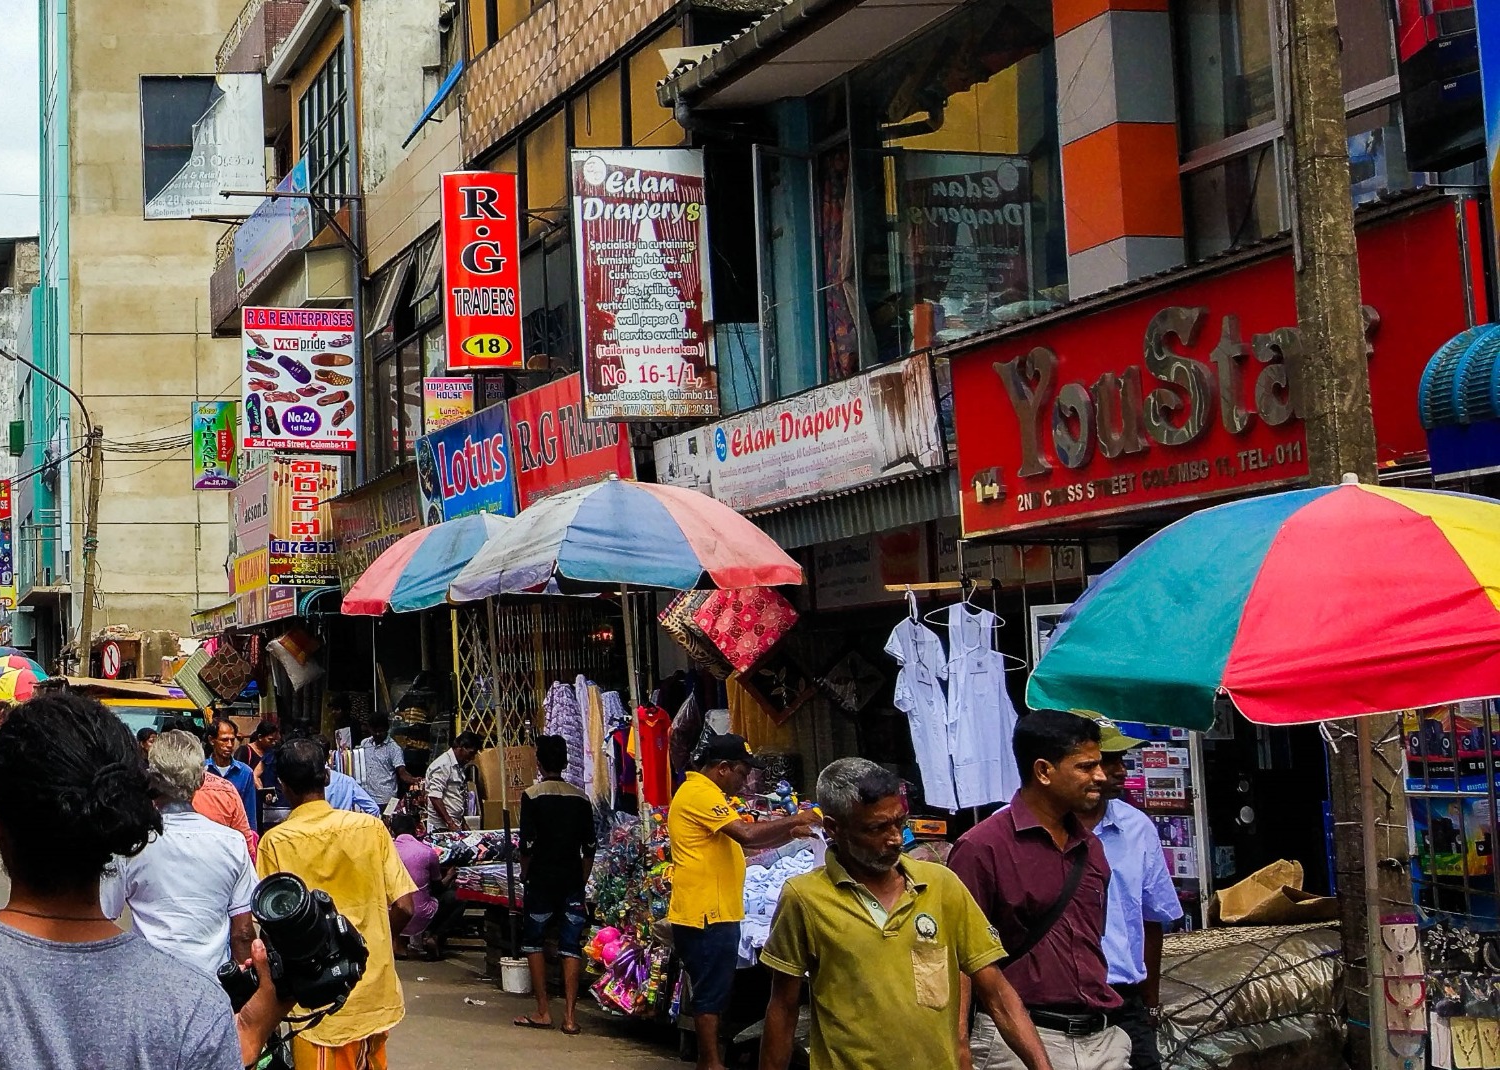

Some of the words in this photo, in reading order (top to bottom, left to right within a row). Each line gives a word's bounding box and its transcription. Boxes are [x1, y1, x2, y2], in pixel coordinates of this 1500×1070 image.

[606, 170, 674, 193] Edan
[583, 198, 701, 225] Draperys
[589, 239, 637, 253] Specialists
[638, 239, 648, 249] in
[596, 254, 642, 267] furnishing
[643, 253, 677, 265] fabrics,
[680, 252, 692, 264] All
[608, 269, 649, 280] Cushions
[650, 269, 682, 280] Covers
[614, 284, 642, 297] poles,
[643, 284, 681, 297] railings,
[453, 287, 515, 317] TRADERS
[596, 299, 632, 311] vertical
[633, 299, 664, 312] blinds,
[665, 300, 697, 313] carpet,
[247, 311, 254, 324] R
[258, 311, 266, 324] &
[269, 312, 276, 325] R
[280, 312, 353, 327] ENTERPRISES
[617, 314, 640, 326] wall
[640, 315, 670, 328] paper
[670, 314, 679, 325] &
[602, 329, 618, 341] full
[619, 330, 654, 341] service
[654, 328, 698, 341] available
[274, 339, 299, 350] VKC
[300, 337, 326, 352] pride
[473, 338, 501, 353] 18
[596, 343, 641, 358] (Tailoring
[601, 365, 633, 385] No.
[638, 362, 704, 388] 16-1/1,
[426, 383, 441, 391] TOP
[444, 383, 473, 391] EATING
[993, 304, 1380, 478] YouSta
[436, 391, 463, 399] HOUSE
[589, 390, 617, 402] Second
[618, 390, 639, 401] Cross
[640, 389, 667, 402] Street,
[668, 390, 703, 401] Colombo
[287, 411, 316, 424] No.24
[439, 407, 460, 415] Lunch
[731, 417, 776, 458] Edan
[779, 397, 864, 442] Draperys
[266, 440, 286, 448] Cross
[287, 440, 310, 449] Street,
[517, 412, 557, 473] R.G
[438, 433, 508, 500] Lotus
[1141, 458, 1209, 491] COLOMBO
[1236, 447, 1274, 472] TEL:
[1275, 440, 1302, 465] 011
[976, 480, 1000, 503] 14
